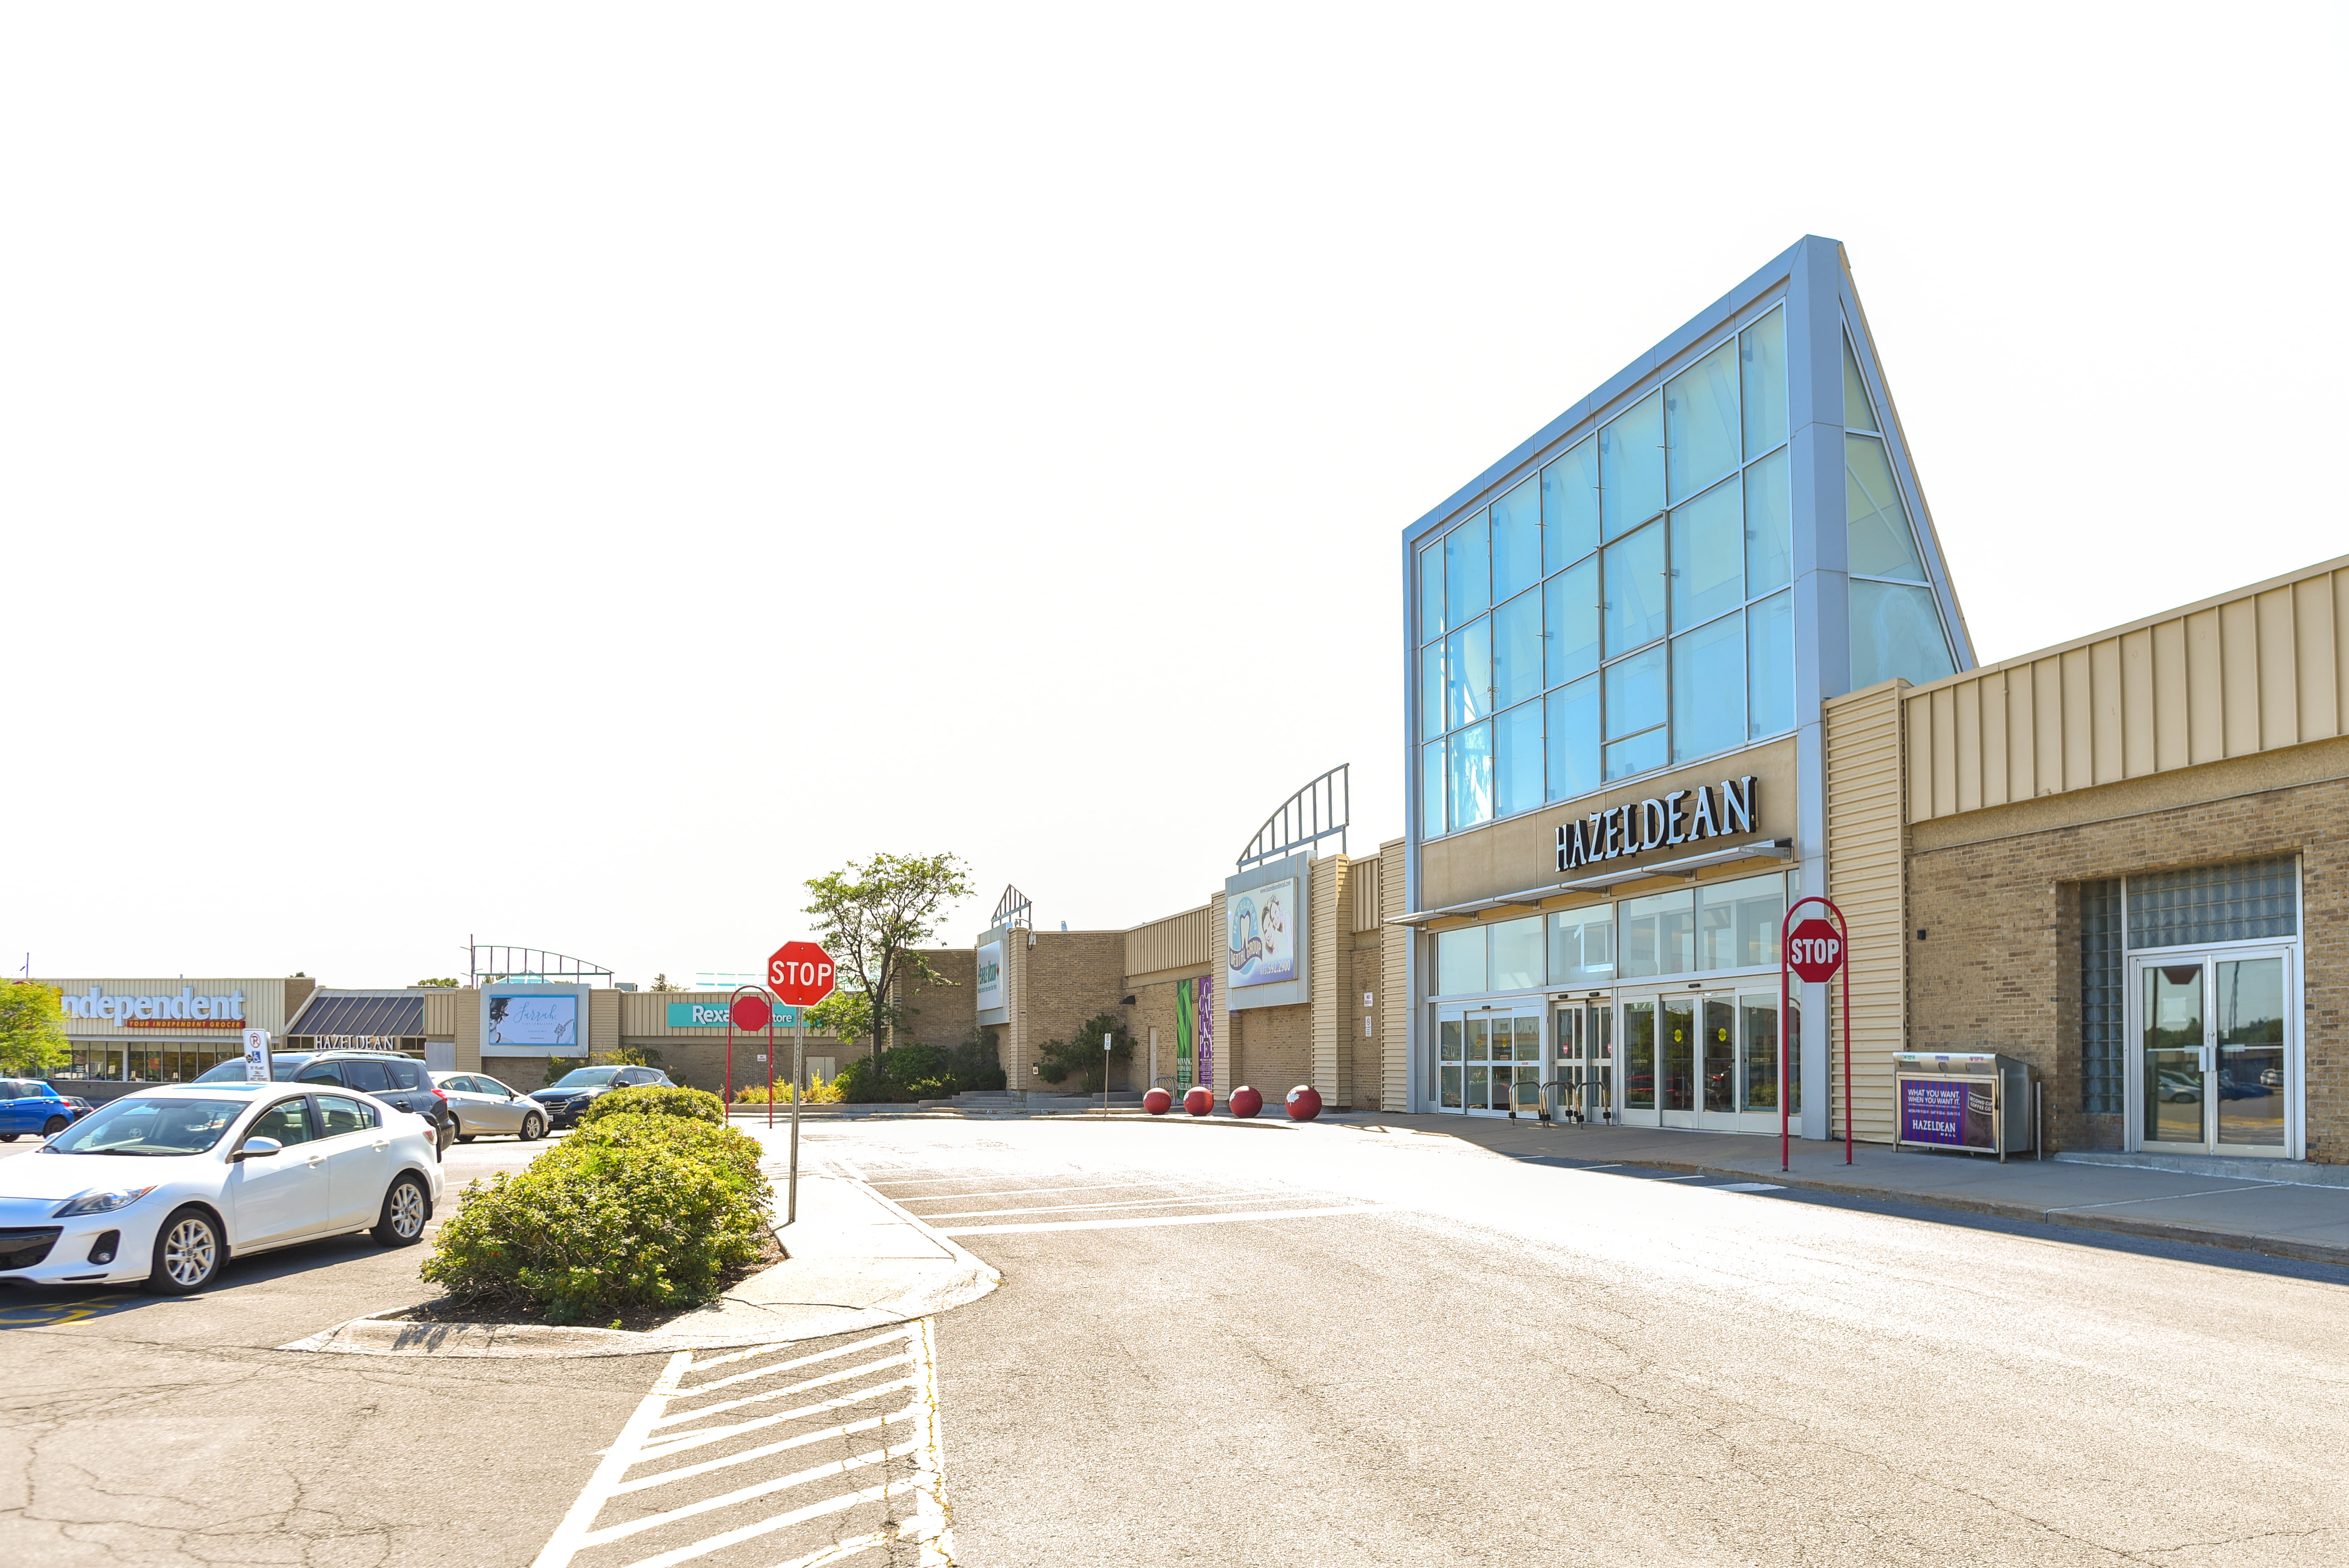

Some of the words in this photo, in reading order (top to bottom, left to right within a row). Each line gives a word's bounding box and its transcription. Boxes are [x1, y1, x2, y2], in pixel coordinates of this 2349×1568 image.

[1555, 775, 1757, 873] HAZELDEAN
[1233, 899, 1257, 935] HAZELDEAN
[1230, 948, 1246, 968] DENTAL
[1246, 941, 1261, 959] GROUP
[1792, 938, 1839, 965] STOP
[771, 960, 832, 986] STOP
[1260, 960, 1291, 975] 613.592.2900
[60, 986, 246, 1026] ndependent
[692, 1005, 730, 1025] Rexa
[772, 1014, 793, 1022] tore
[315, 1034, 396, 1051] HAZELDEAN
[1940, 1090, 1960, 1099] WANT,
[1913, 1120, 1956, 1133] HAZELDEAN
